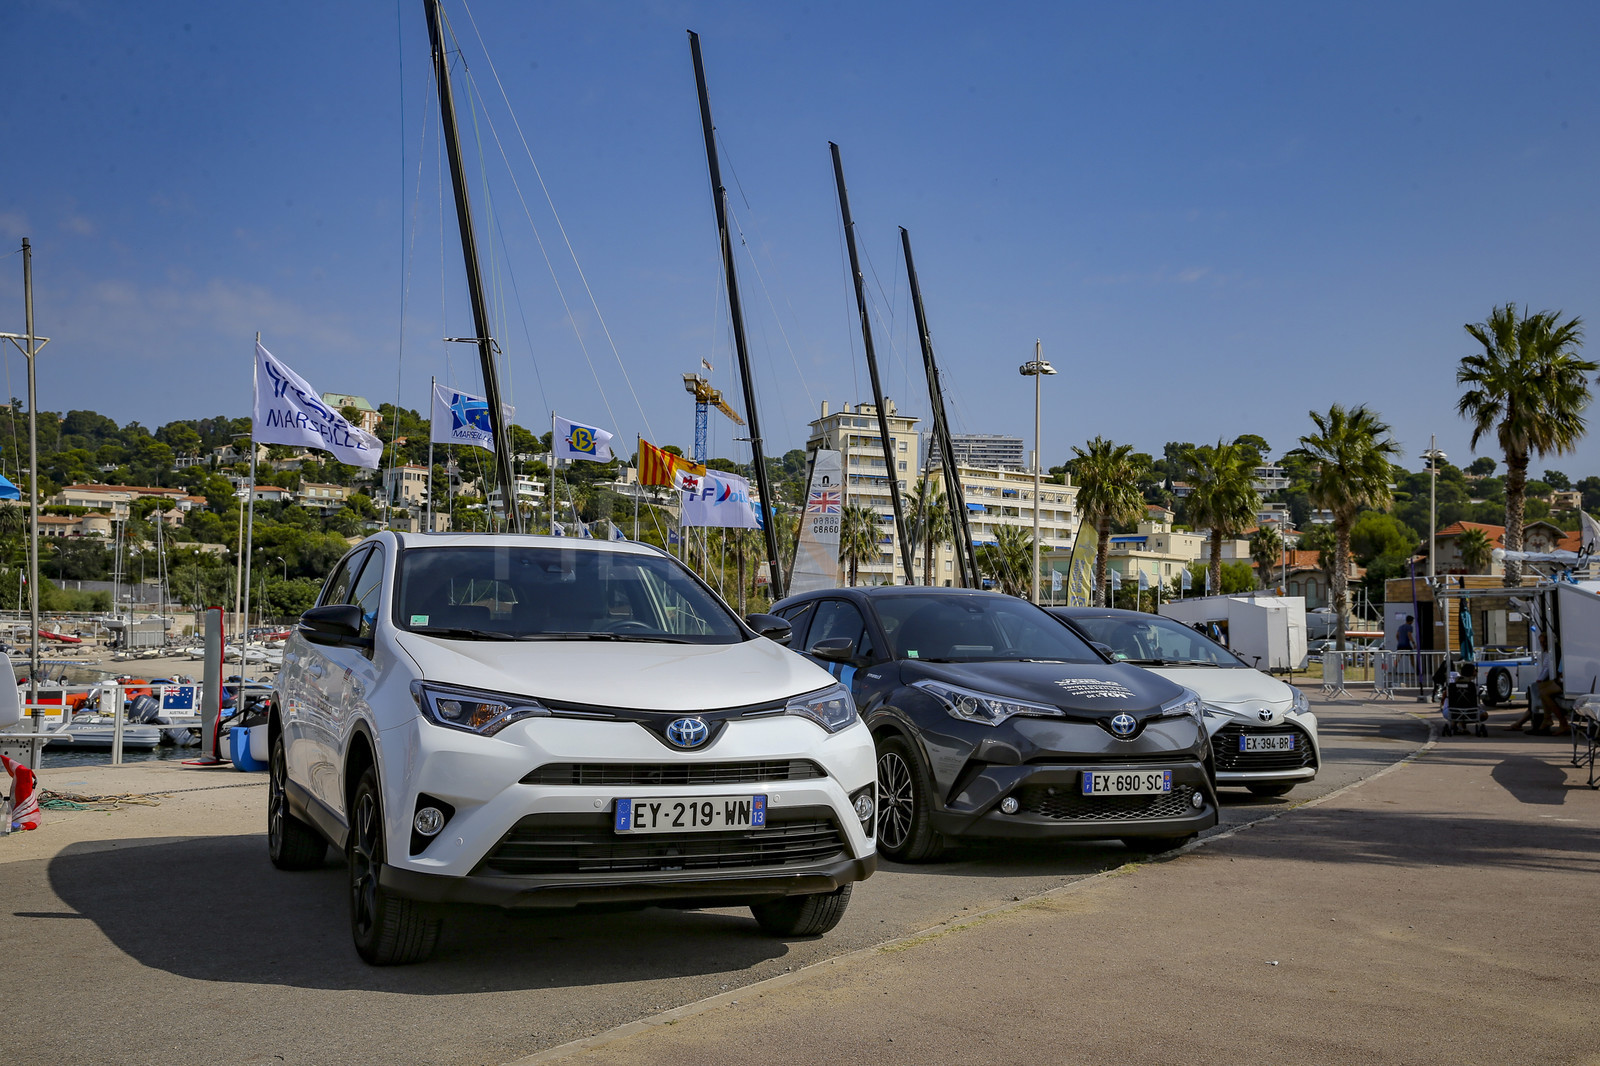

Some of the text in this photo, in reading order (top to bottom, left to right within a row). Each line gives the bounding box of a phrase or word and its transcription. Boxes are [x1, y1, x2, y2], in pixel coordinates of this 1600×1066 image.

[576, 431, 592, 449] 13
[1246, 737, 1289, 750] EX-394-BR
[1093, 774, 1162, 792] EX-690-SC
[620, 817, 626, 825] F
[633, 800, 751, 829] EY-219-WN
[753, 811, 764, 824] 13
